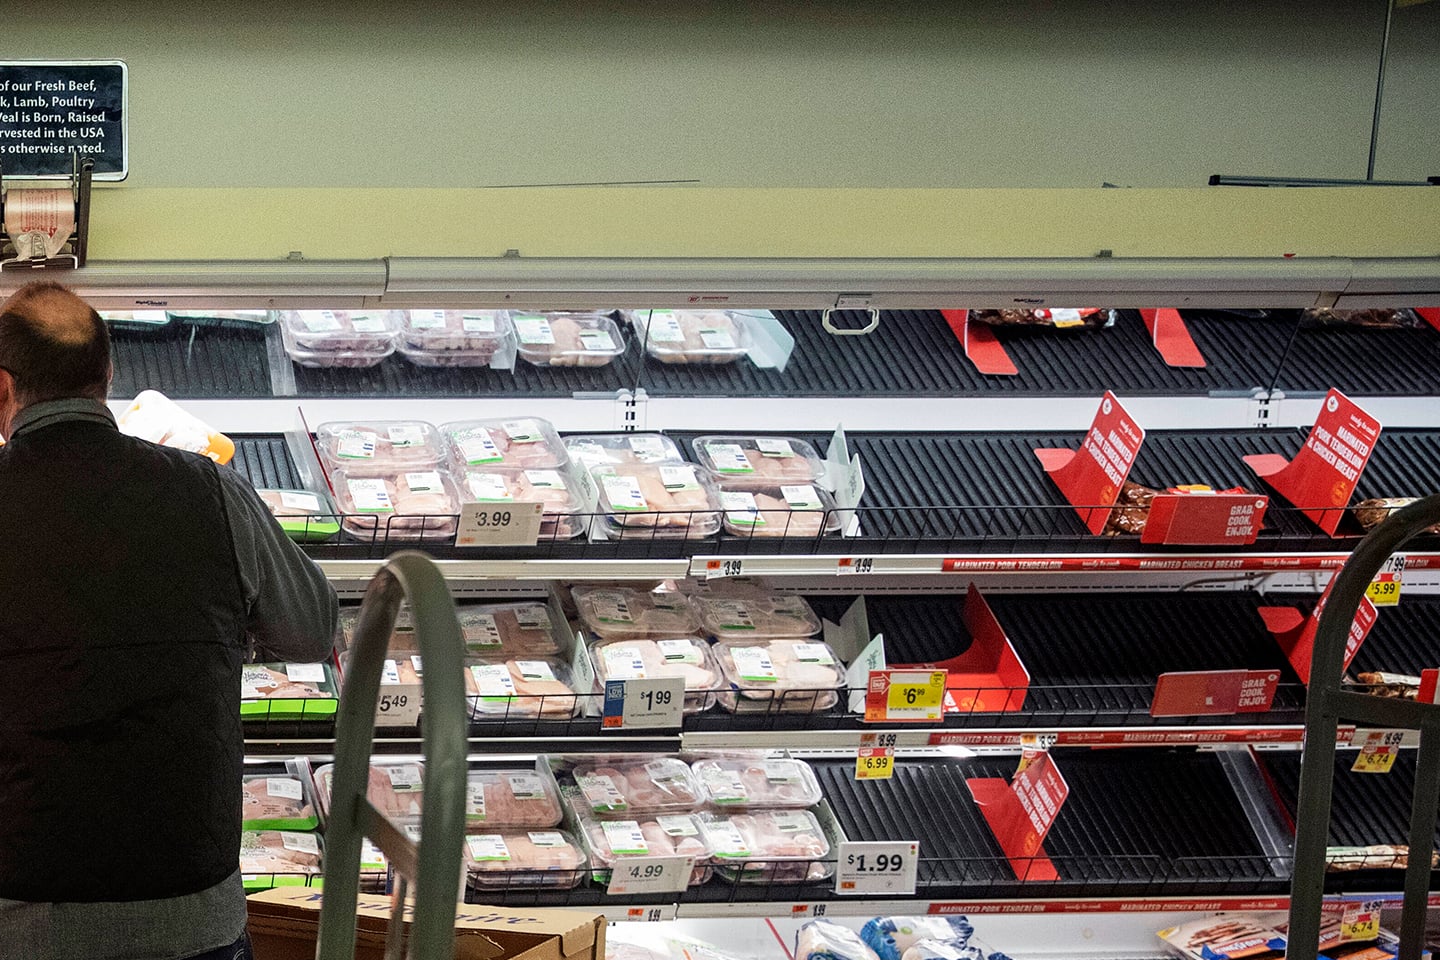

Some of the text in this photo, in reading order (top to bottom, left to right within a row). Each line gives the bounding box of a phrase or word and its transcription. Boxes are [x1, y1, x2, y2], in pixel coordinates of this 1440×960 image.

[12, 82, 33, 92] our
[35, 80, 66, 92] Fresh
[68, 80, 97, 93] Beef,
[13, 96, 49, 108] Lamb,
[52, 96, 95, 110] Poultry
[22, 112, 31, 123] is
[33, 112, 66, 124] Born,
[68, 112, 106, 123] Raised
[44, 128, 56, 139] in
[58, 127, 78, 139] the
[80, 128, 105, 139] USA
[8, 143, 66, 154] otherwise
[68, 143, 106, 154] noted.
[1314, 425, 1364, 468] PORK TENDERLOIN
[1336, 426, 1370, 457] MARINATED
[1312, 442, 1337, 468] CHICKEN
[1334, 458, 1359, 483] BREAST
[1230, 504, 1255, 517] GRAB.
[475, 511, 512, 527] $3.99
[1227, 515, 1252, 527] COOK.
[1224, 525, 1254, 537] ENJOY.
[953, 560, 996, 570] MARINATED
[996, 560, 1017, 569] PORK
[1138, 560, 1181, 569] MARINATED
[1181, 560, 1213, 569] CHICKEN
[1213, 559, 1244, 569] BREAST
[1371, 583, 1395, 595] $5.99
[1241, 679, 1266, 689] GRAB.
[1239, 688, 1265, 698] COOK.
[1238, 696, 1267, 707] ENJOY.
[864, 757, 888, 769] $6.99
[1364, 753, 1389, 766] $6.74
[847, 854, 904, 873] $1.99
[628, 865, 664, 879] $4.99
[1348, 922, 1374, 934] $6.74
